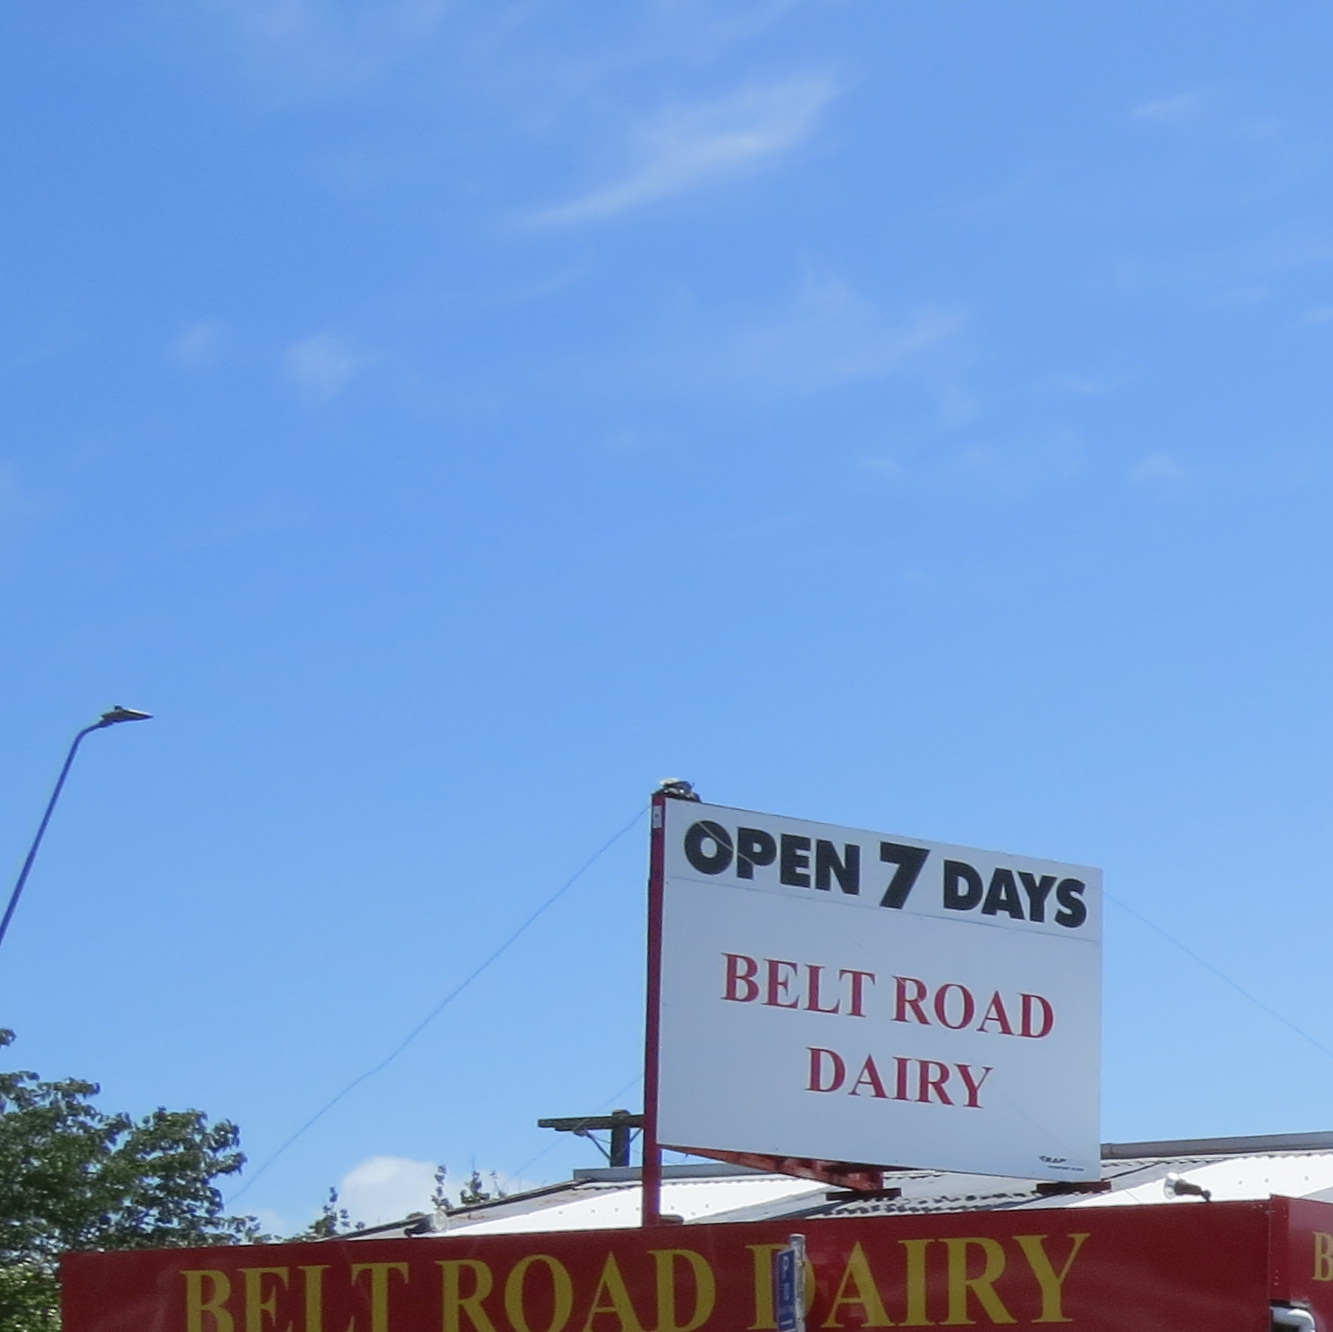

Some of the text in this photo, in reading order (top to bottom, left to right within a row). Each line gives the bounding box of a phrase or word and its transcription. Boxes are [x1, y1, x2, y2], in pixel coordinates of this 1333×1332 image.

[684, 820, 1087, 929] OPEN 7 DAYS
[720, 952, 1054, 1039] BELT ROAD
[805, 1047, 993, 1109] DAIRY
